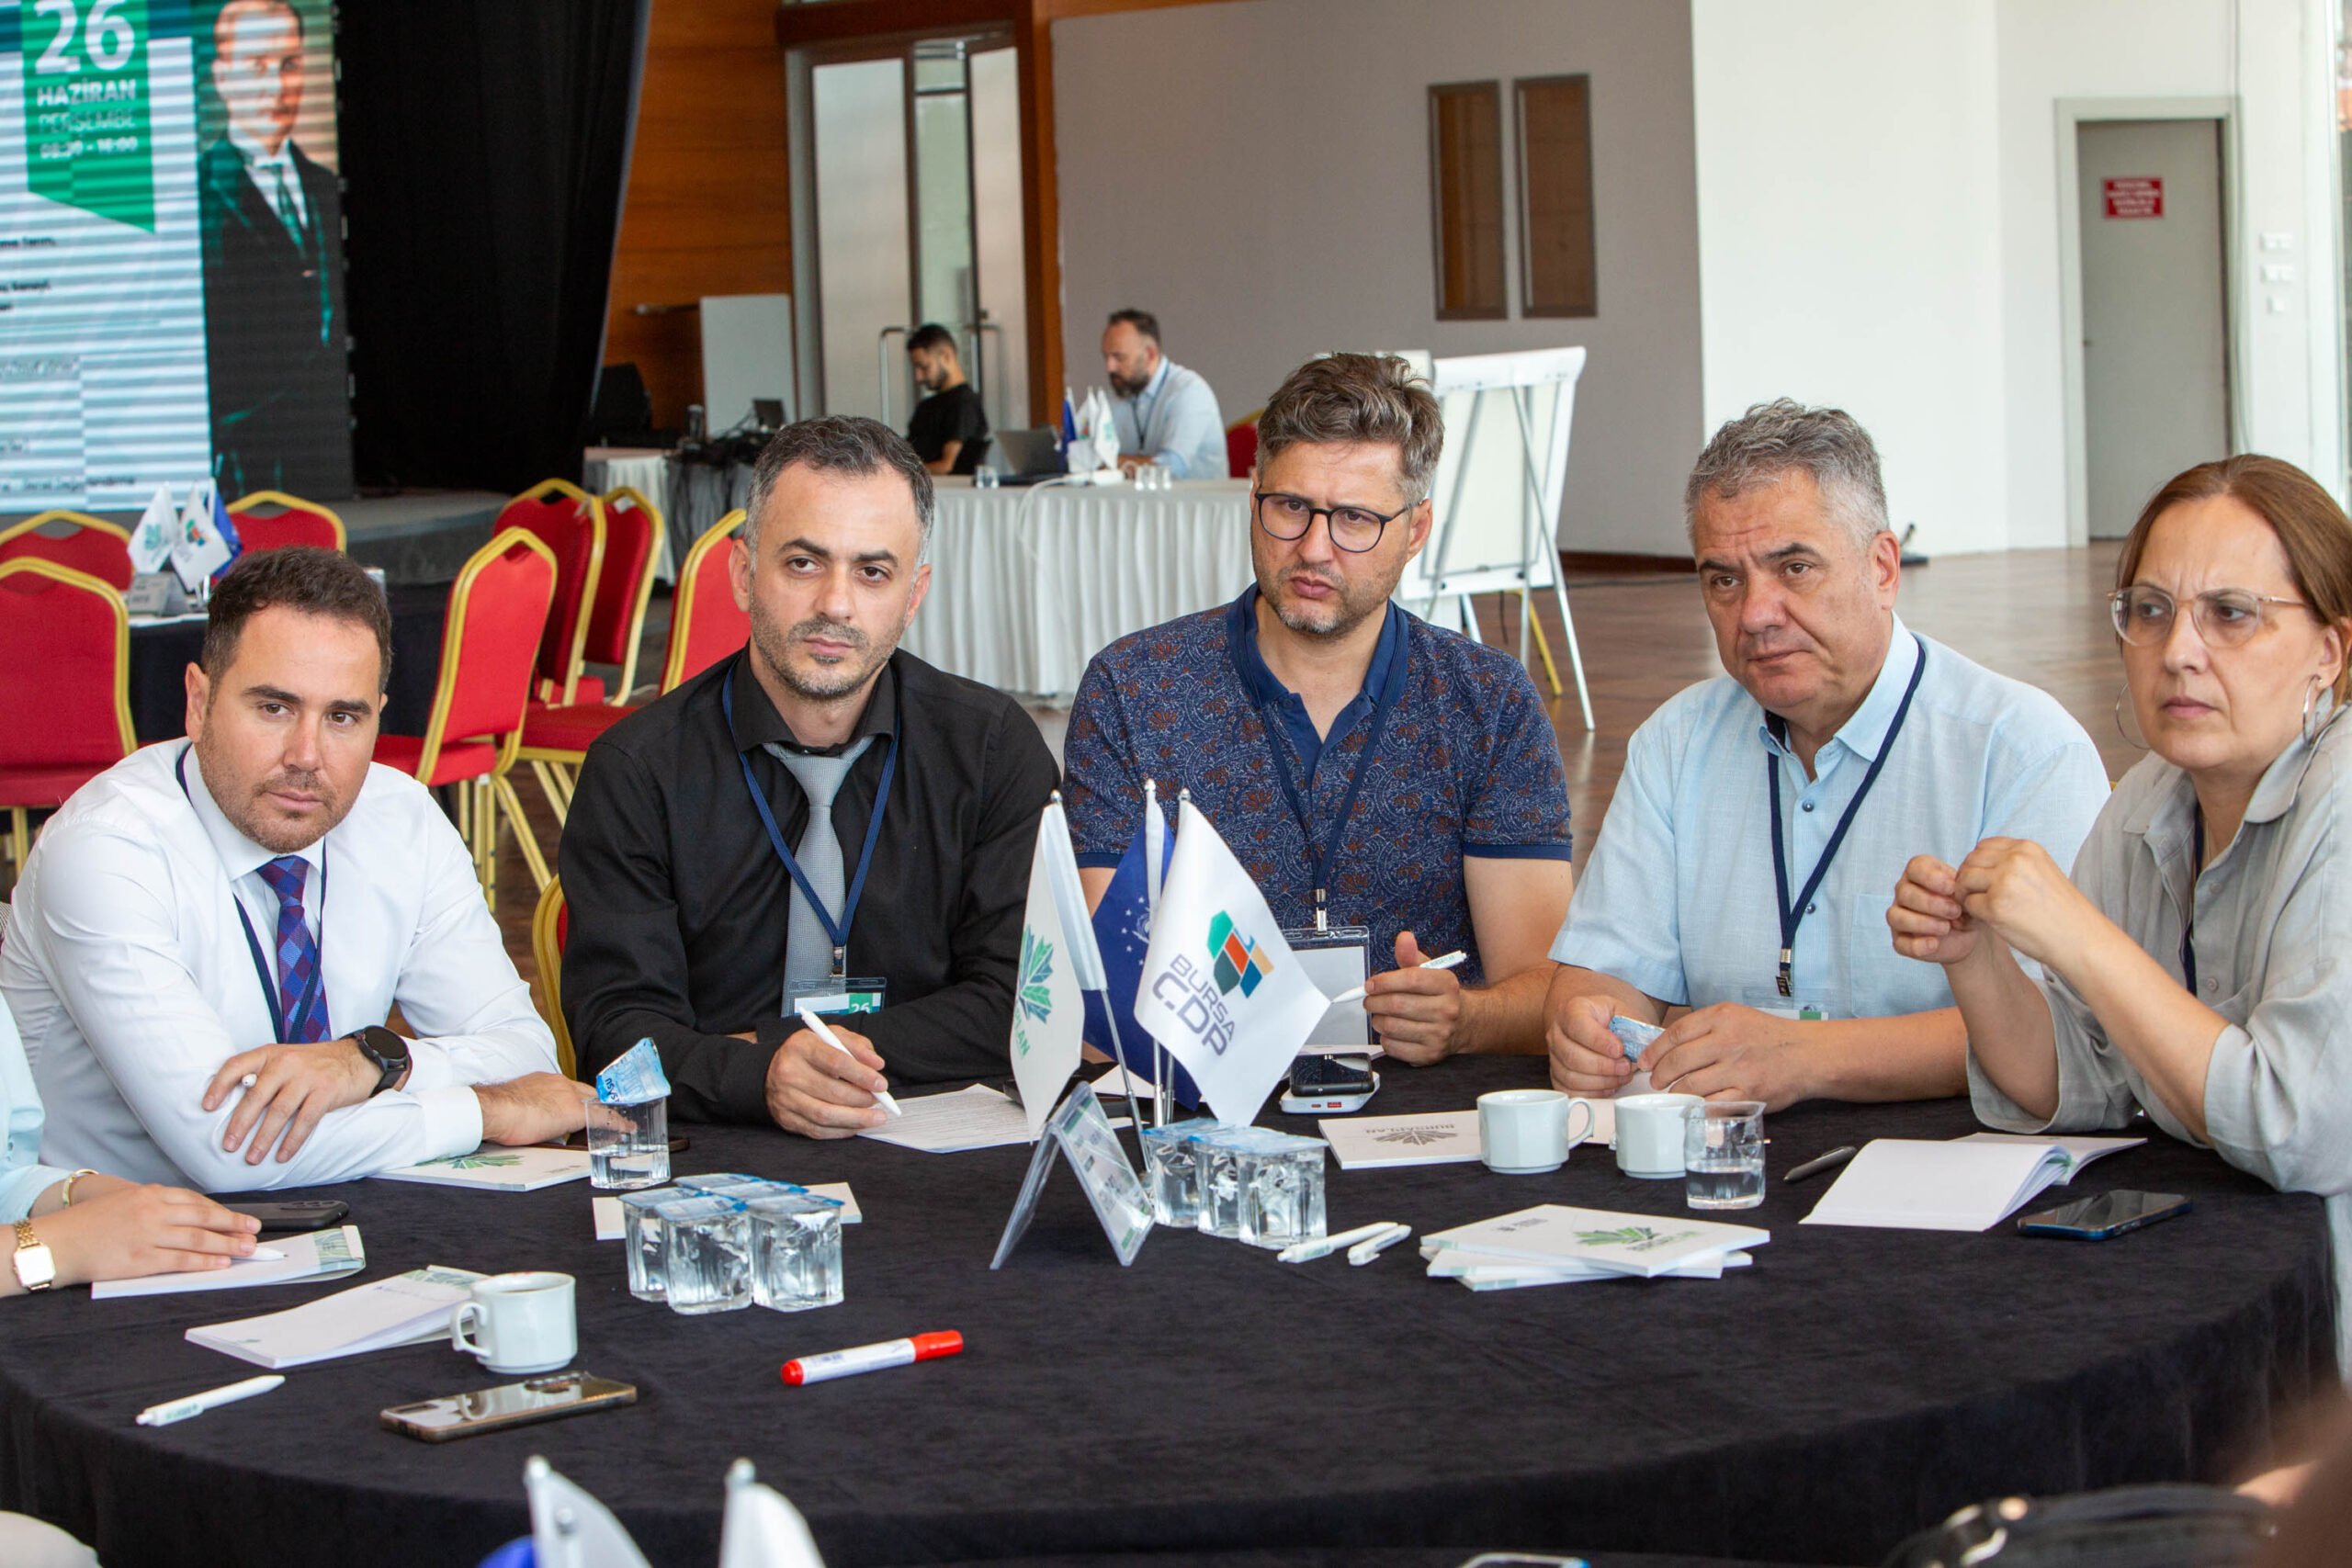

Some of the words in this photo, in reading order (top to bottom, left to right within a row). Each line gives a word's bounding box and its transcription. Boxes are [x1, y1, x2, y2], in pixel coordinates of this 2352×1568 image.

[34, 0, 135, 73] 26
[38, 77, 137, 107] HAZİRAN
[1170, 953, 1235, 1041] BURSA
